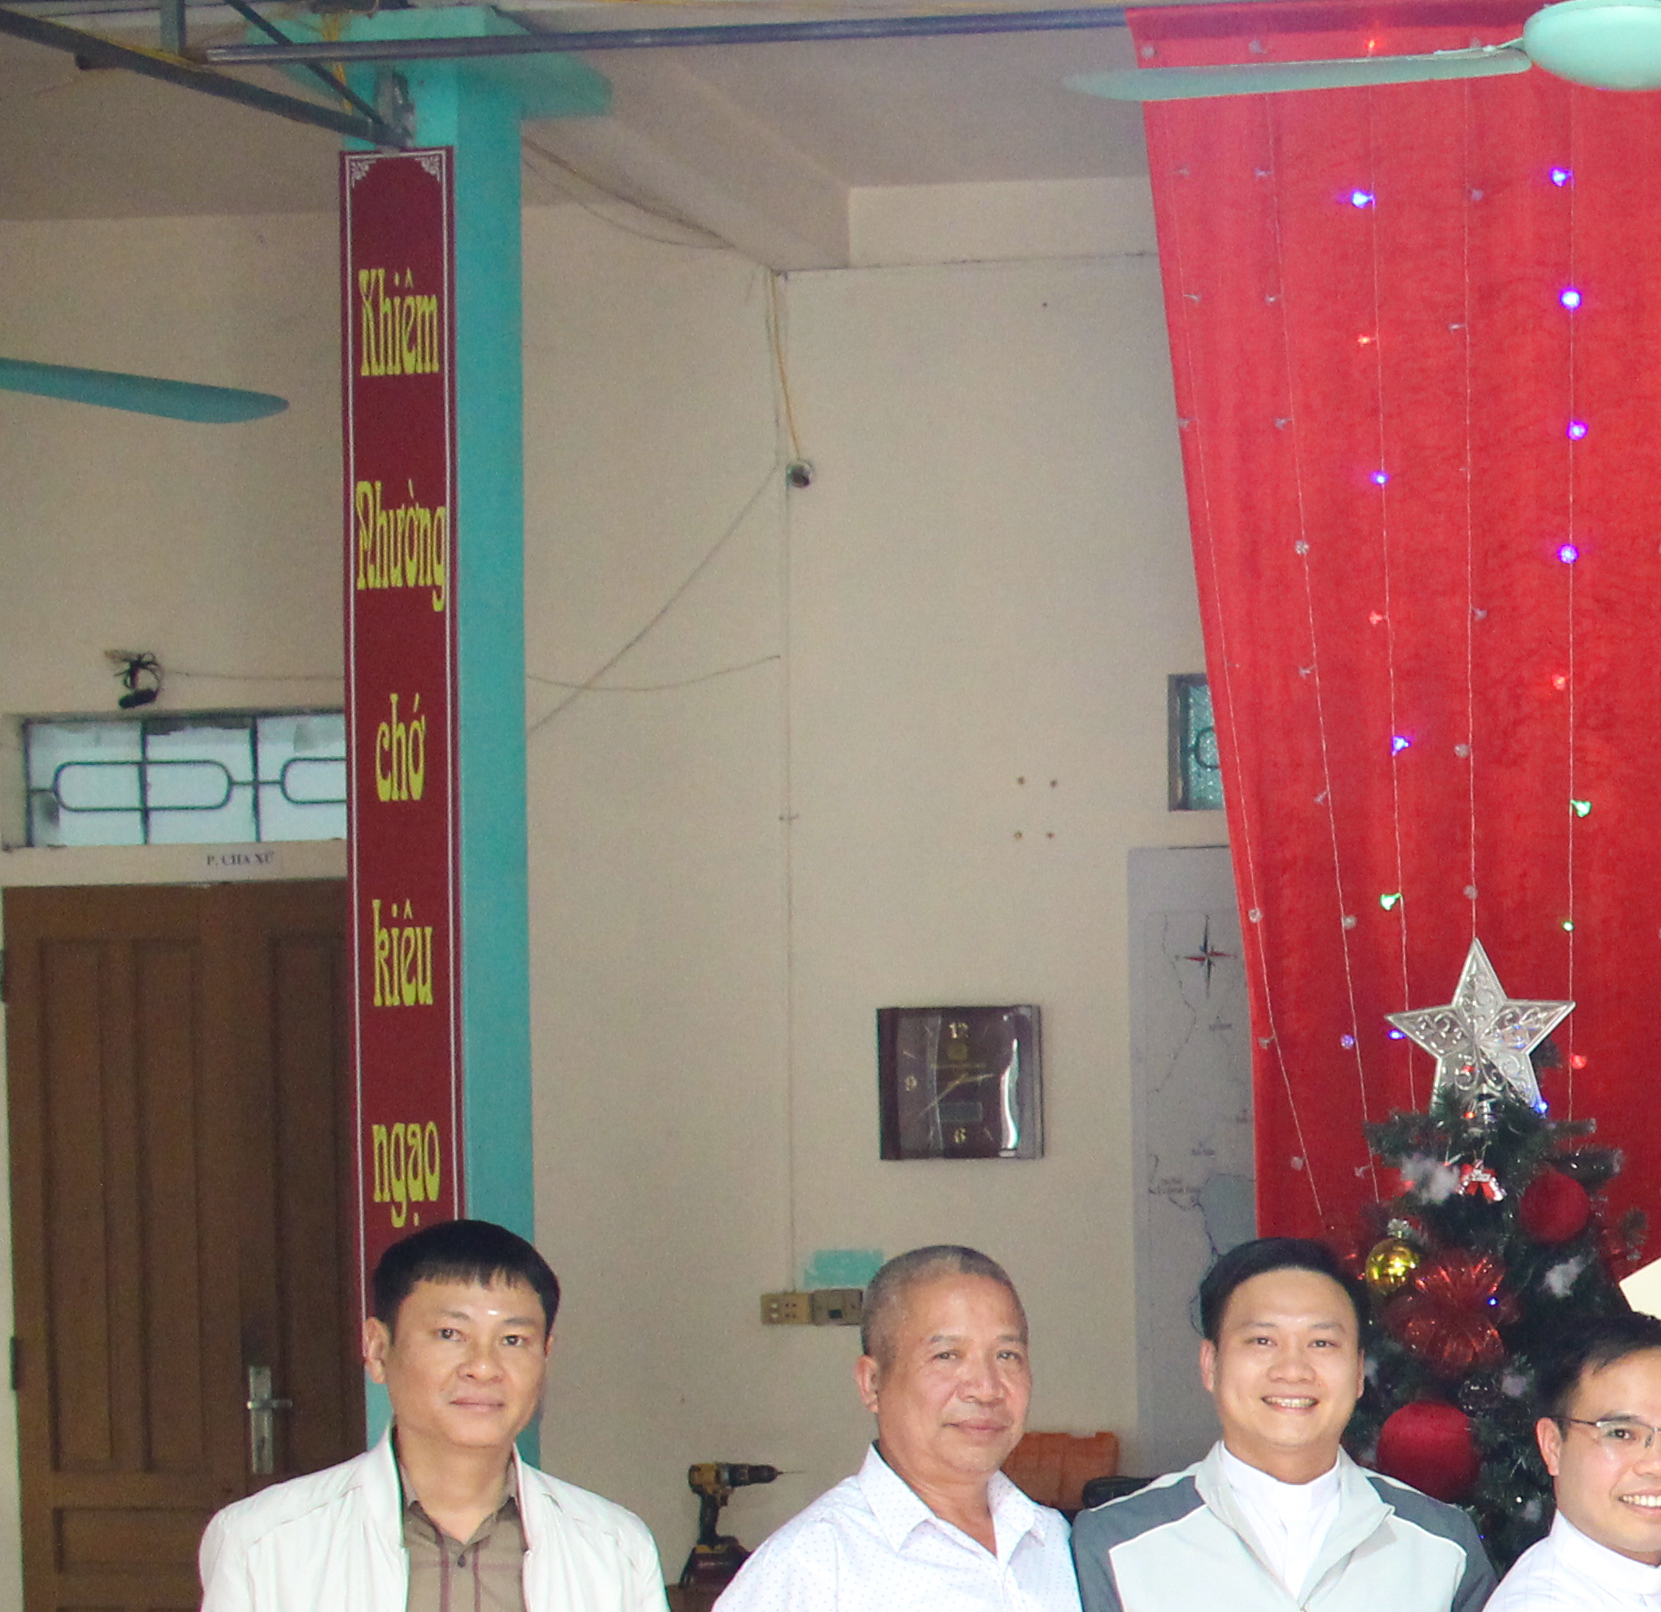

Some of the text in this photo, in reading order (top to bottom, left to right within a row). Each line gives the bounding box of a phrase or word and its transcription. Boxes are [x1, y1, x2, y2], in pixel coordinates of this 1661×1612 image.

[357, 266, 440, 376] Khiêm
[375, 693, 427, 802] chớ
[372, 898, 434, 1007] kiêu
[371, 1121, 442, 1229] ngạo
